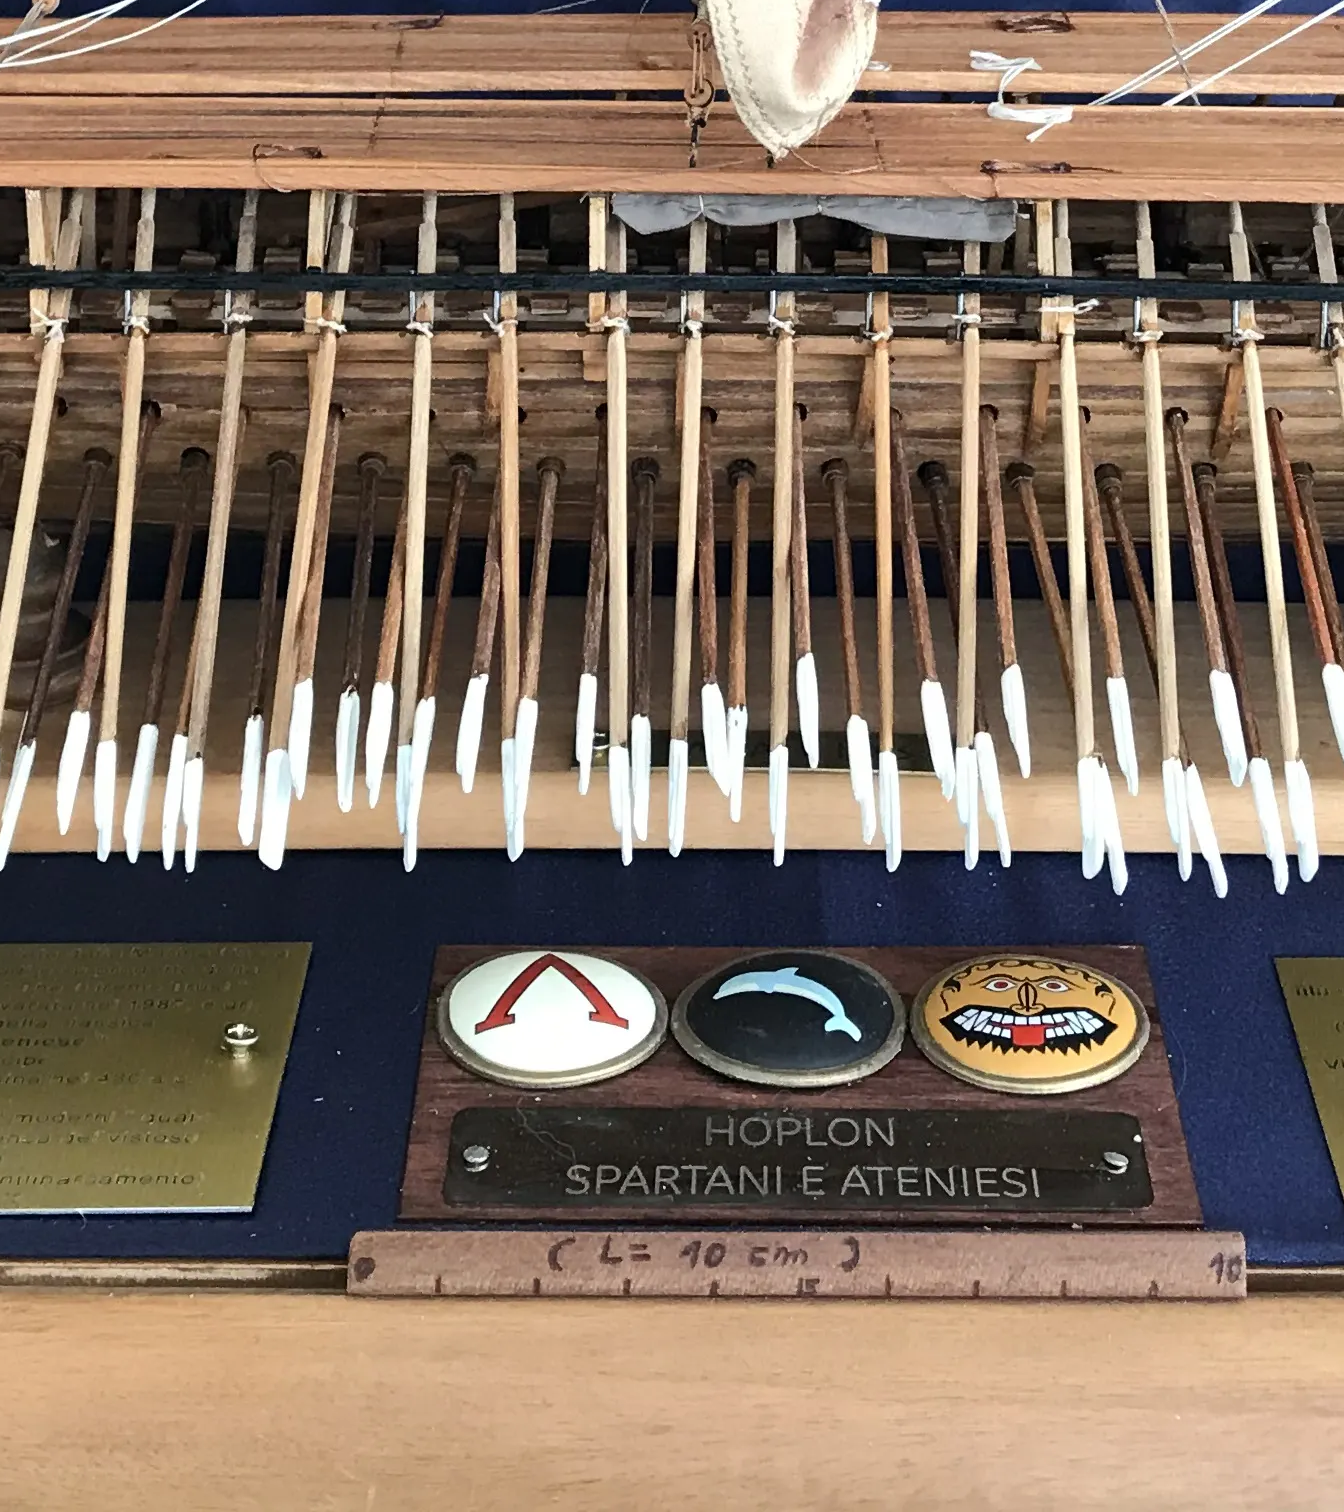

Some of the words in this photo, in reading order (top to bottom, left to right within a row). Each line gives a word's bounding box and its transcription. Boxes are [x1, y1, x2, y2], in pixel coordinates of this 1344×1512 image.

[704, 1116, 896, 1148] HOPLON
[564, 1163, 782, 1197] SPARTANI
[802, 1166, 826, 1197] E
[840, 1165, 1042, 1199] ATENIESI
